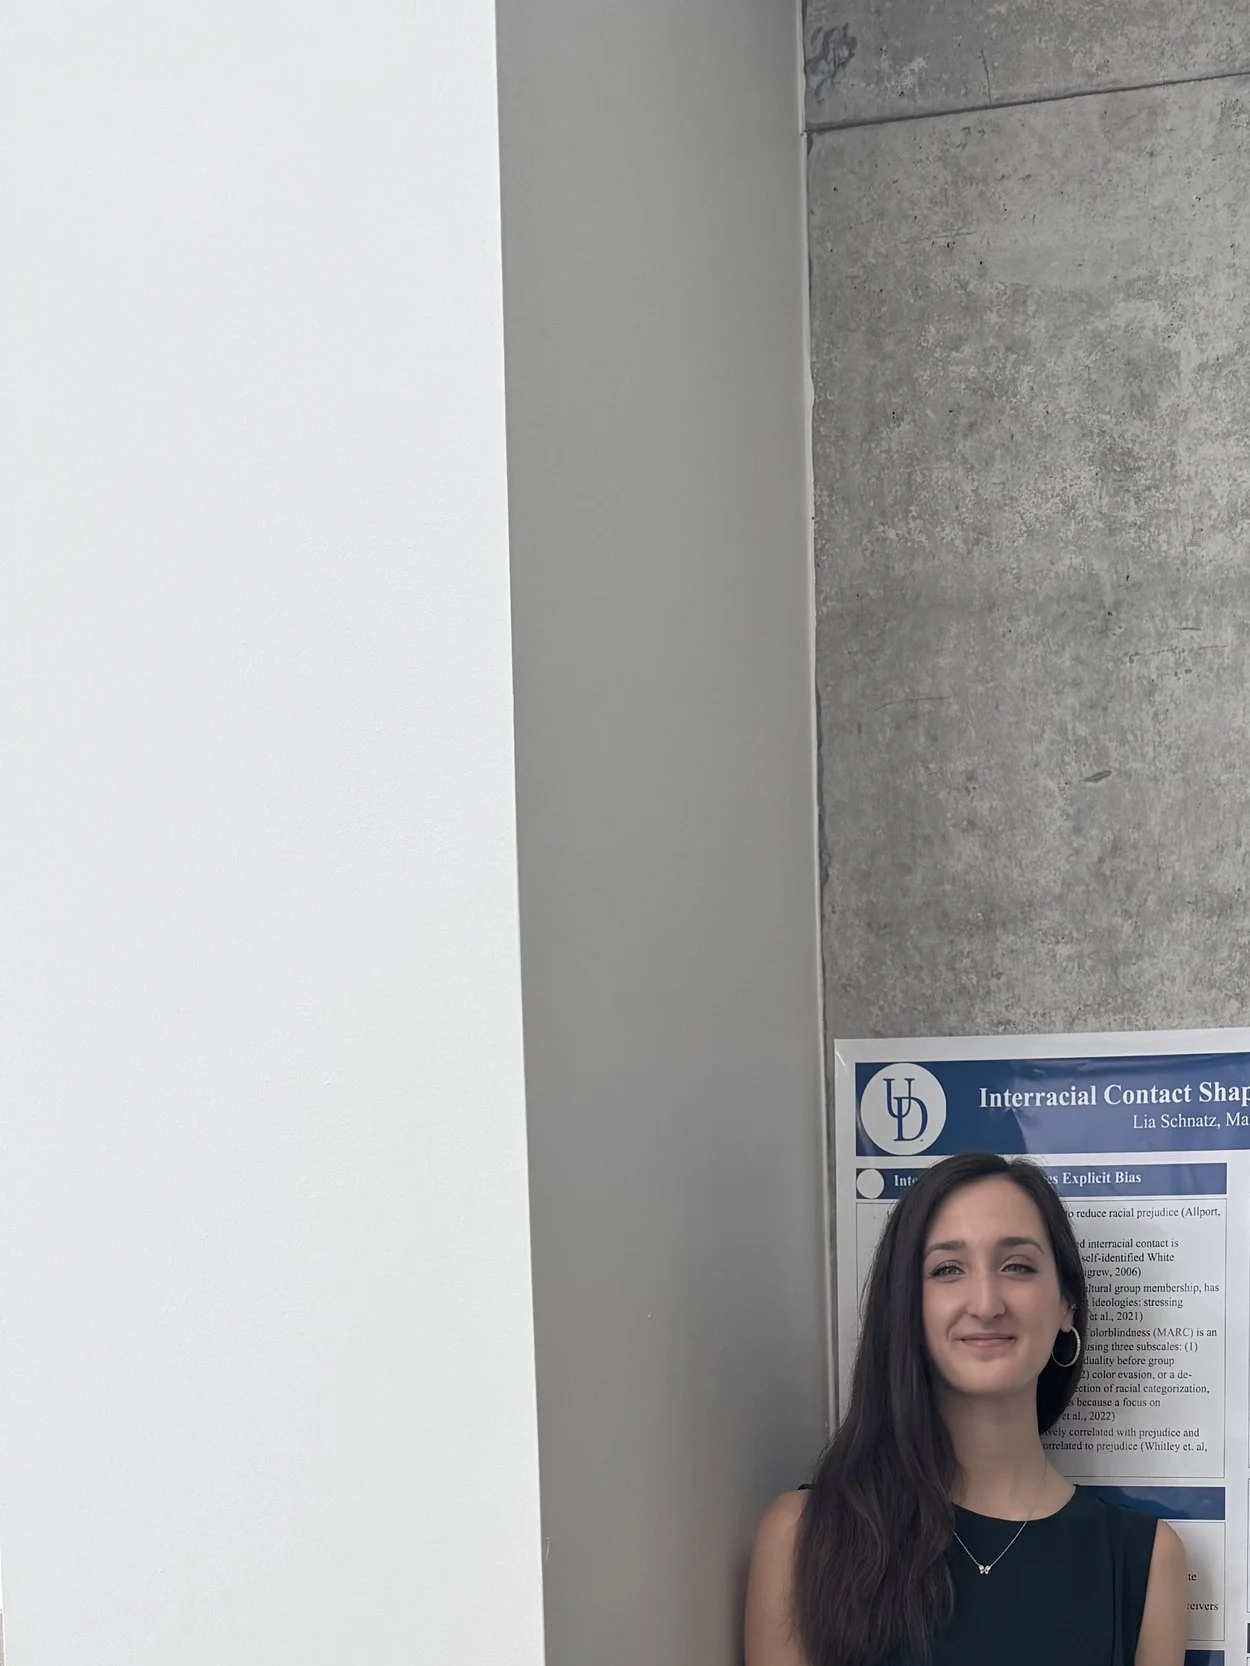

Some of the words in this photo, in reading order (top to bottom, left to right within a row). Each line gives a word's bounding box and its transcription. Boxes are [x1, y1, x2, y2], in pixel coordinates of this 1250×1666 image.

[979, 1085, 1096, 1107] Interracial
[1103, 1083, 1192, 1105] Contact
[1133, 1114, 1156, 1129] Lia
[1160, 1113, 1220, 1129] Schnatz,
[1062, 1171, 1111, 1187] Explicit
[1115, 1171, 1142, 1183] Bias
[1076, 1208, 1107, 1218] reduce
[1108, 1207, 1134, 1218] racial
[1136, 1207, 1179, 1219] prejudice
[1180, 1206, 1220, 1219] (Allport,
